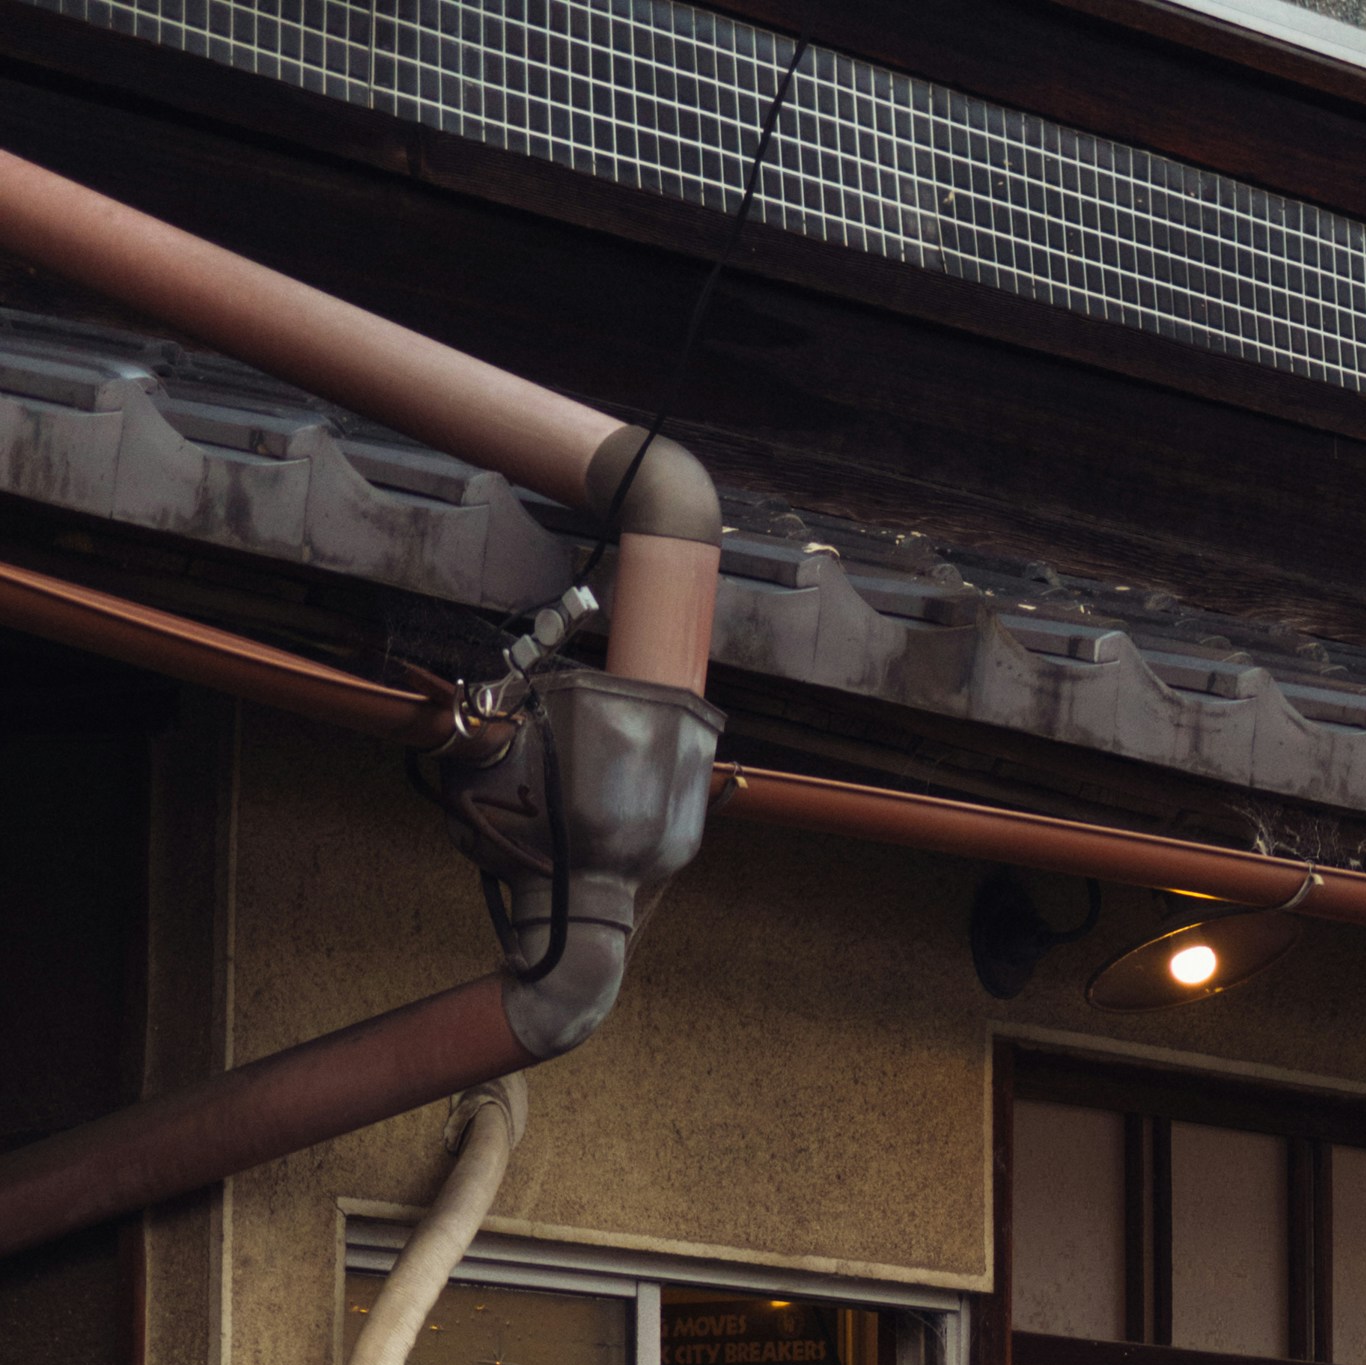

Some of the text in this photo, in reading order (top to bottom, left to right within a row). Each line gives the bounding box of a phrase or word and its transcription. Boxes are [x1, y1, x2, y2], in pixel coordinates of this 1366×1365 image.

[673, 1314, 747, 1338] MOVES
[675, 1343, 721, 1365] CITY
[724, 1340, 826, 1364] BREAKERS
